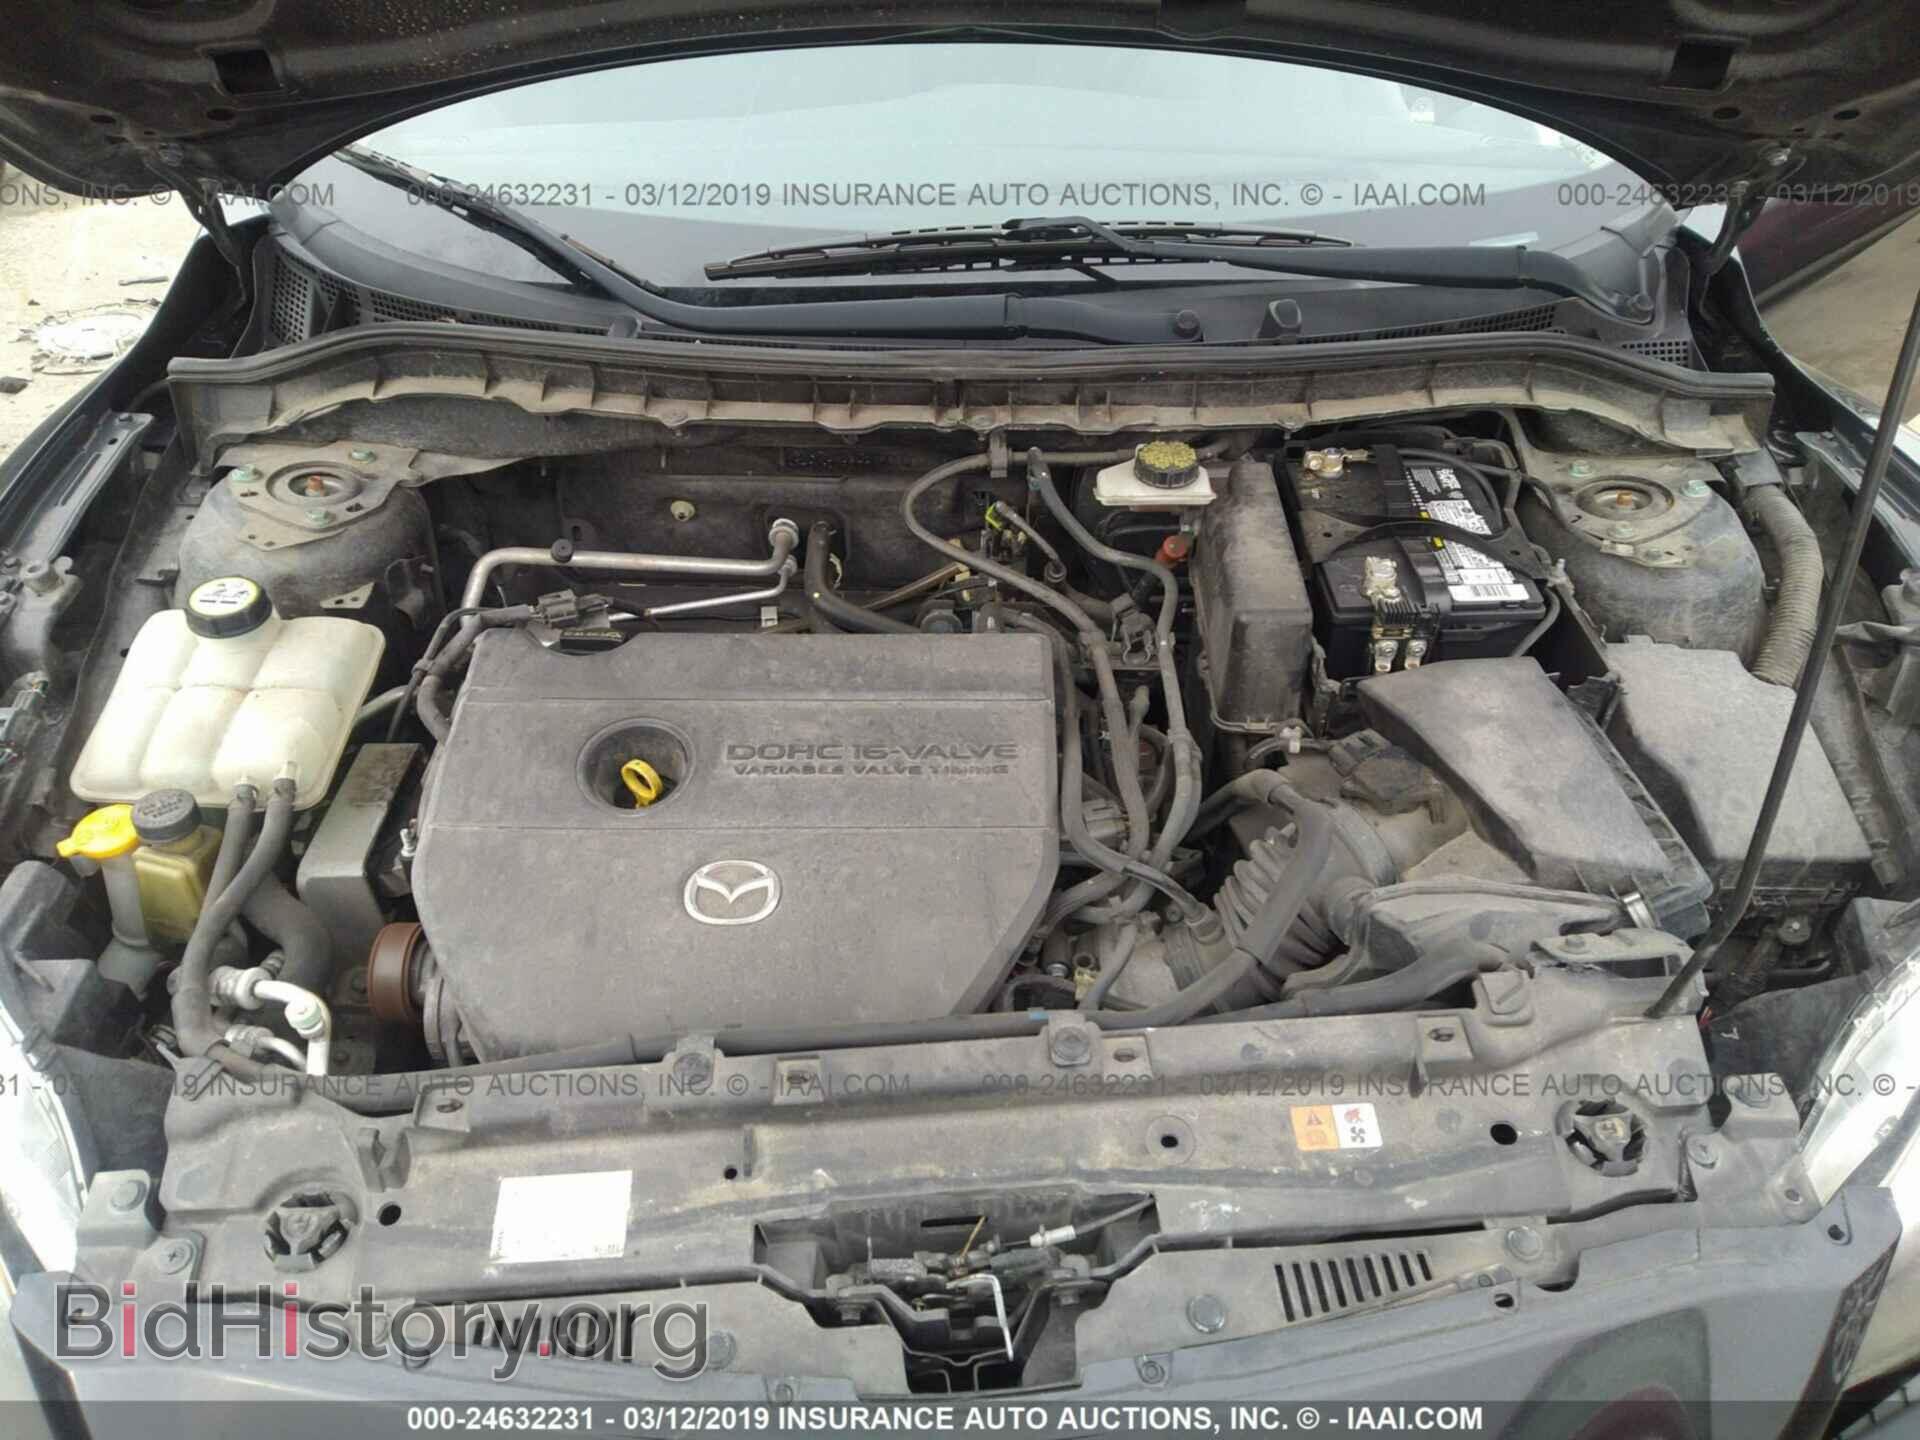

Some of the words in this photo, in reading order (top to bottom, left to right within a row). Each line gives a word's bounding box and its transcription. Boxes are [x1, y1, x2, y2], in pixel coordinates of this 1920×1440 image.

[726, 744, 843, 761] DOHC
[853, 743, 1019, 760] 16-VALVE
[733, 765, 845, 776] VARIABLE
[852, 765, 922, 776] VALVE
